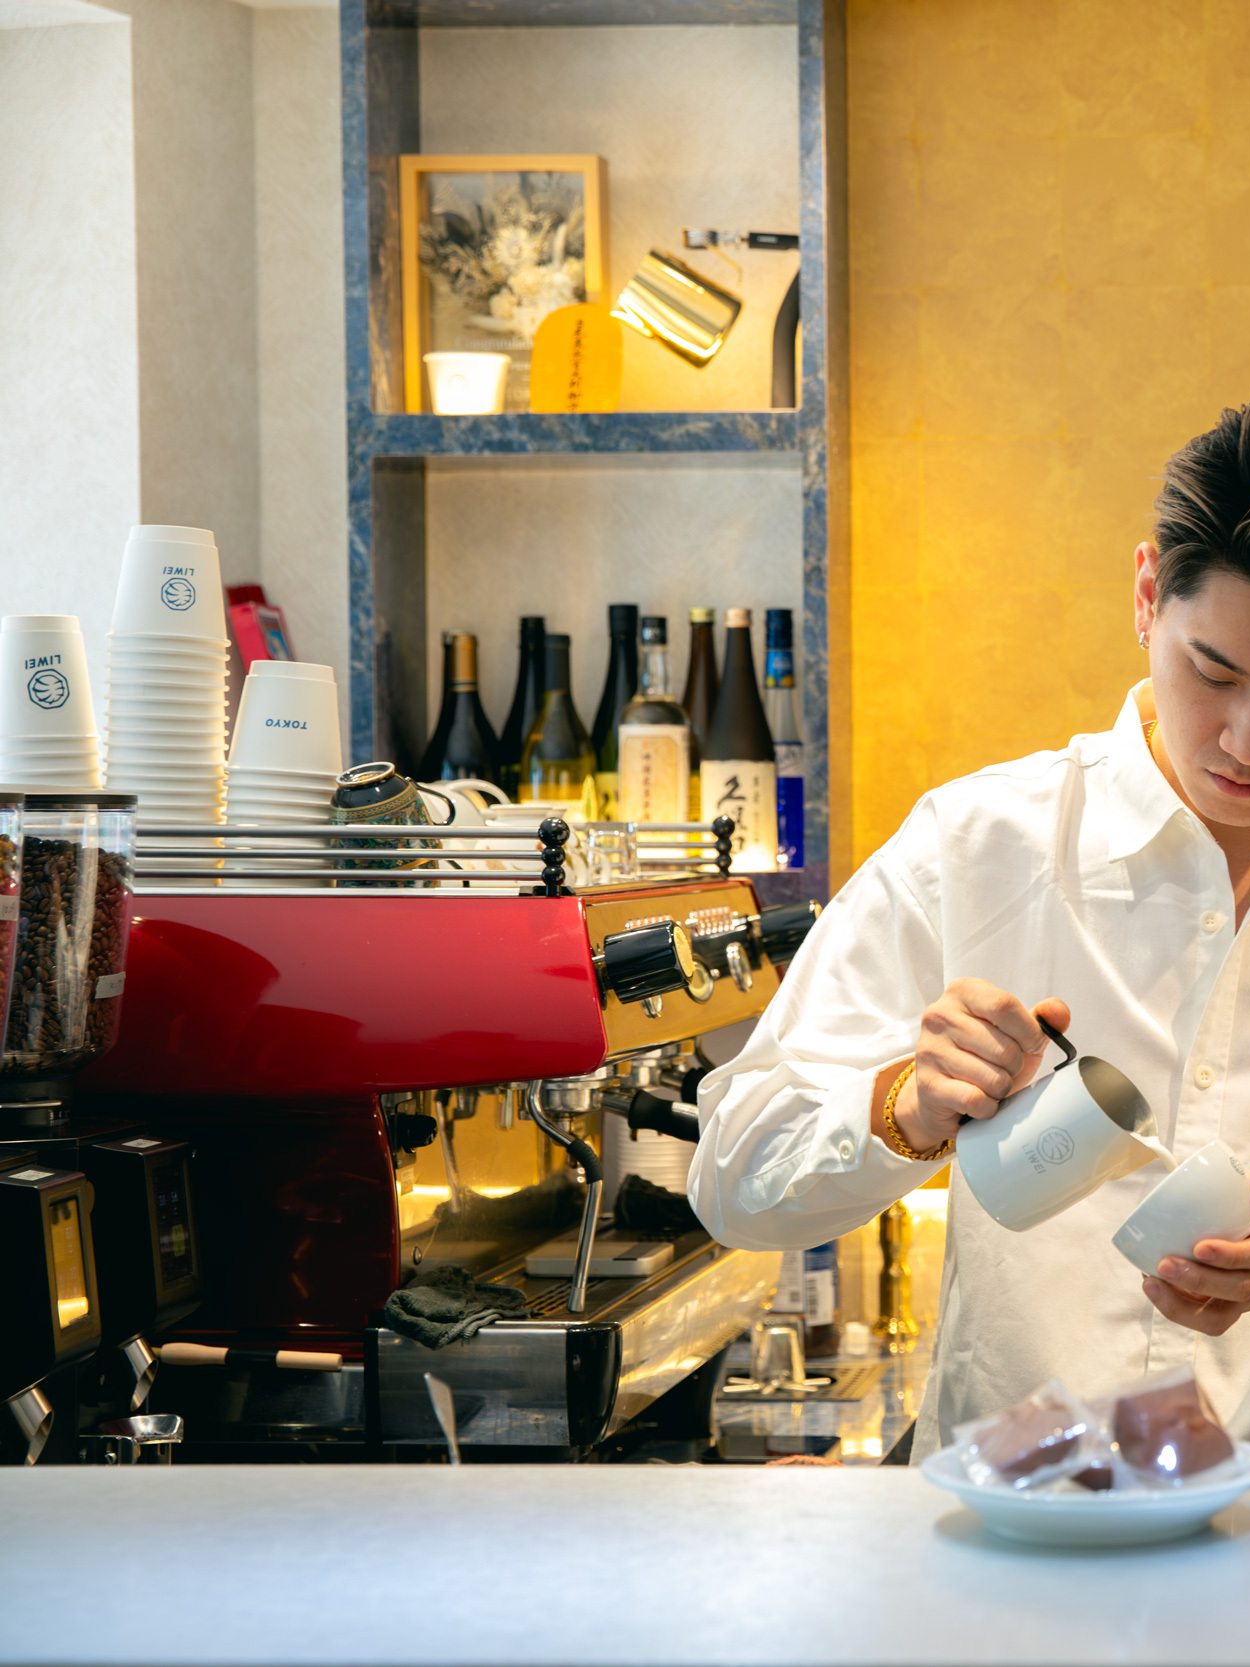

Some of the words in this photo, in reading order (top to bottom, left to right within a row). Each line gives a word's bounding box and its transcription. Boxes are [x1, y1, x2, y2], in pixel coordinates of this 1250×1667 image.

[162, 566, 195, 577] LIWEI
[24, 654, 62, 670] LIWEI
[265, 718, 308, 730] TOKYO
[1021, 1143, 1047, 1175] LIWEI
